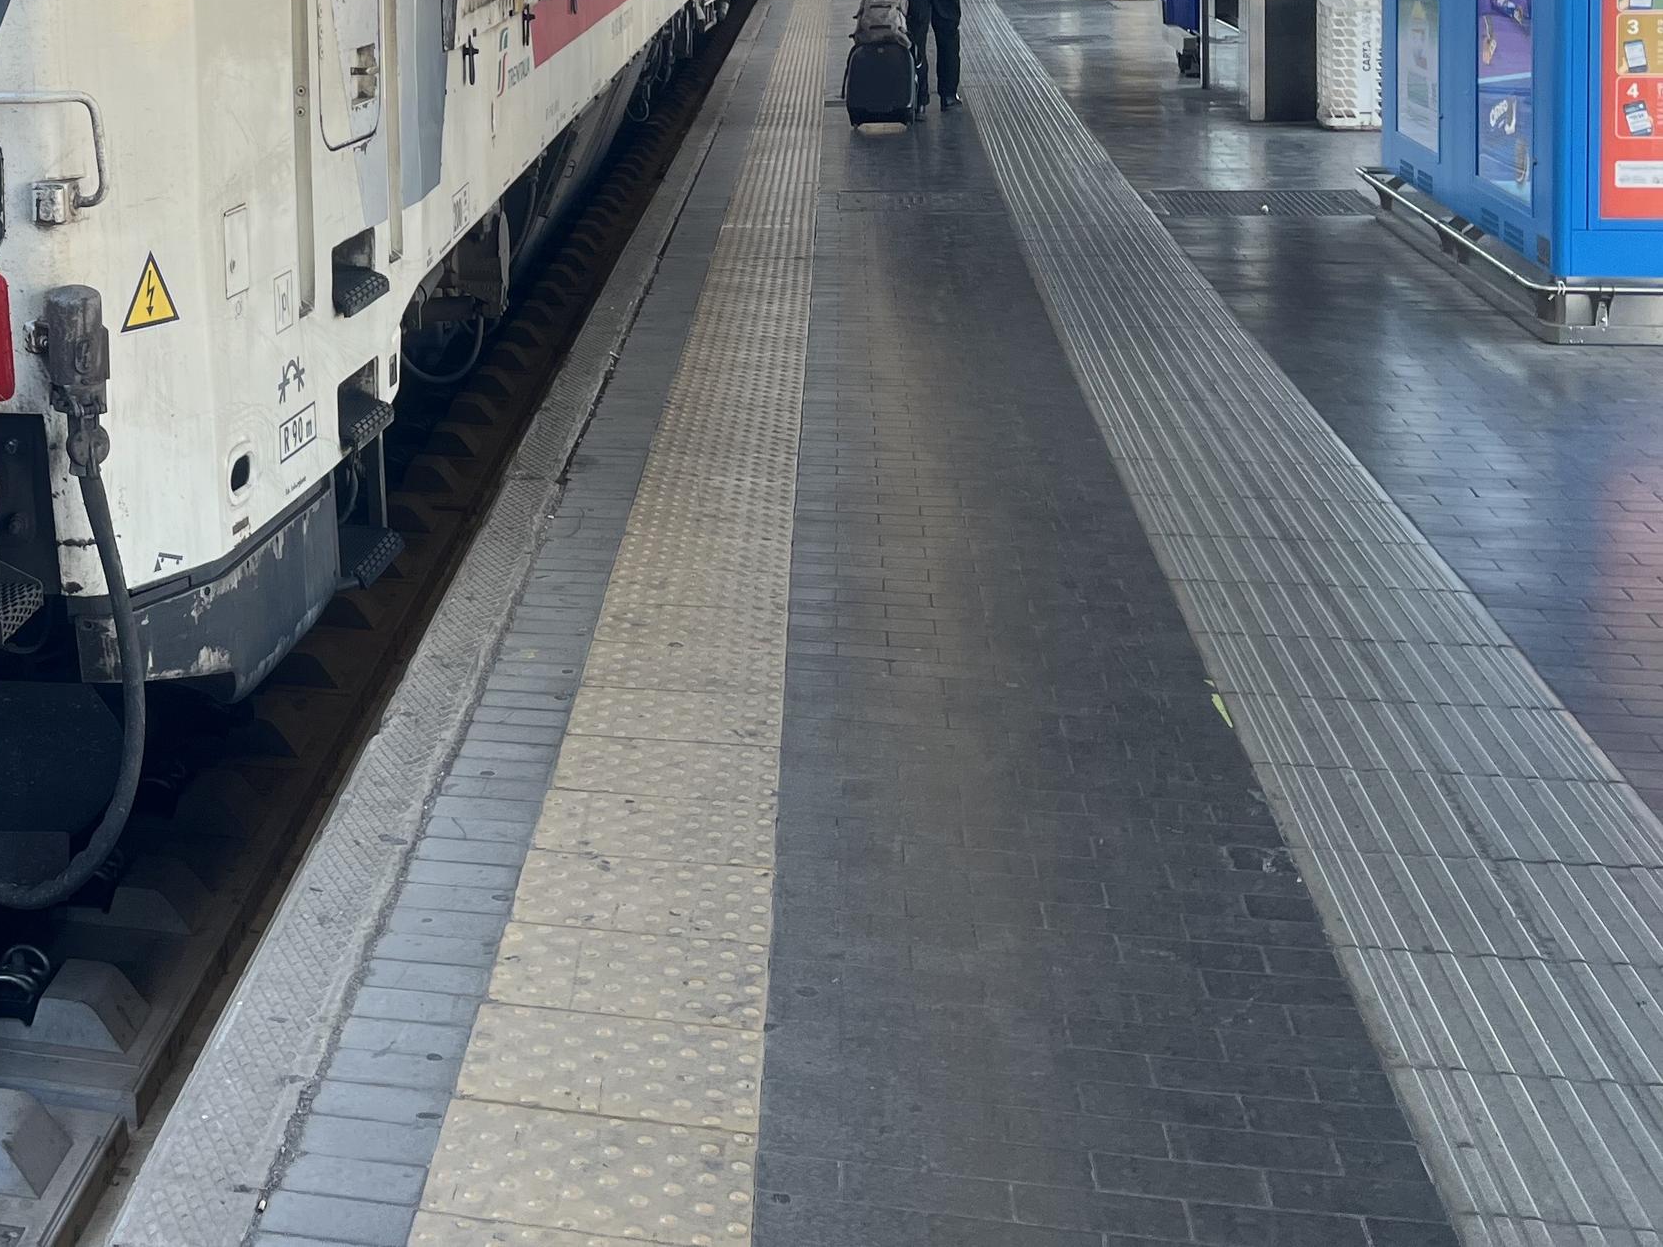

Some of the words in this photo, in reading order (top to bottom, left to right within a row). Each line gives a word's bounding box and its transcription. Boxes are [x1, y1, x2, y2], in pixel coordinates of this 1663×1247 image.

[1627, 19, 1639, 35] 3
[1626, 82, 1639, 98] 4
[284, 426, 290, 454] R
[292, 416, 304, 447] 90
[306, 419, 313, 438] m
